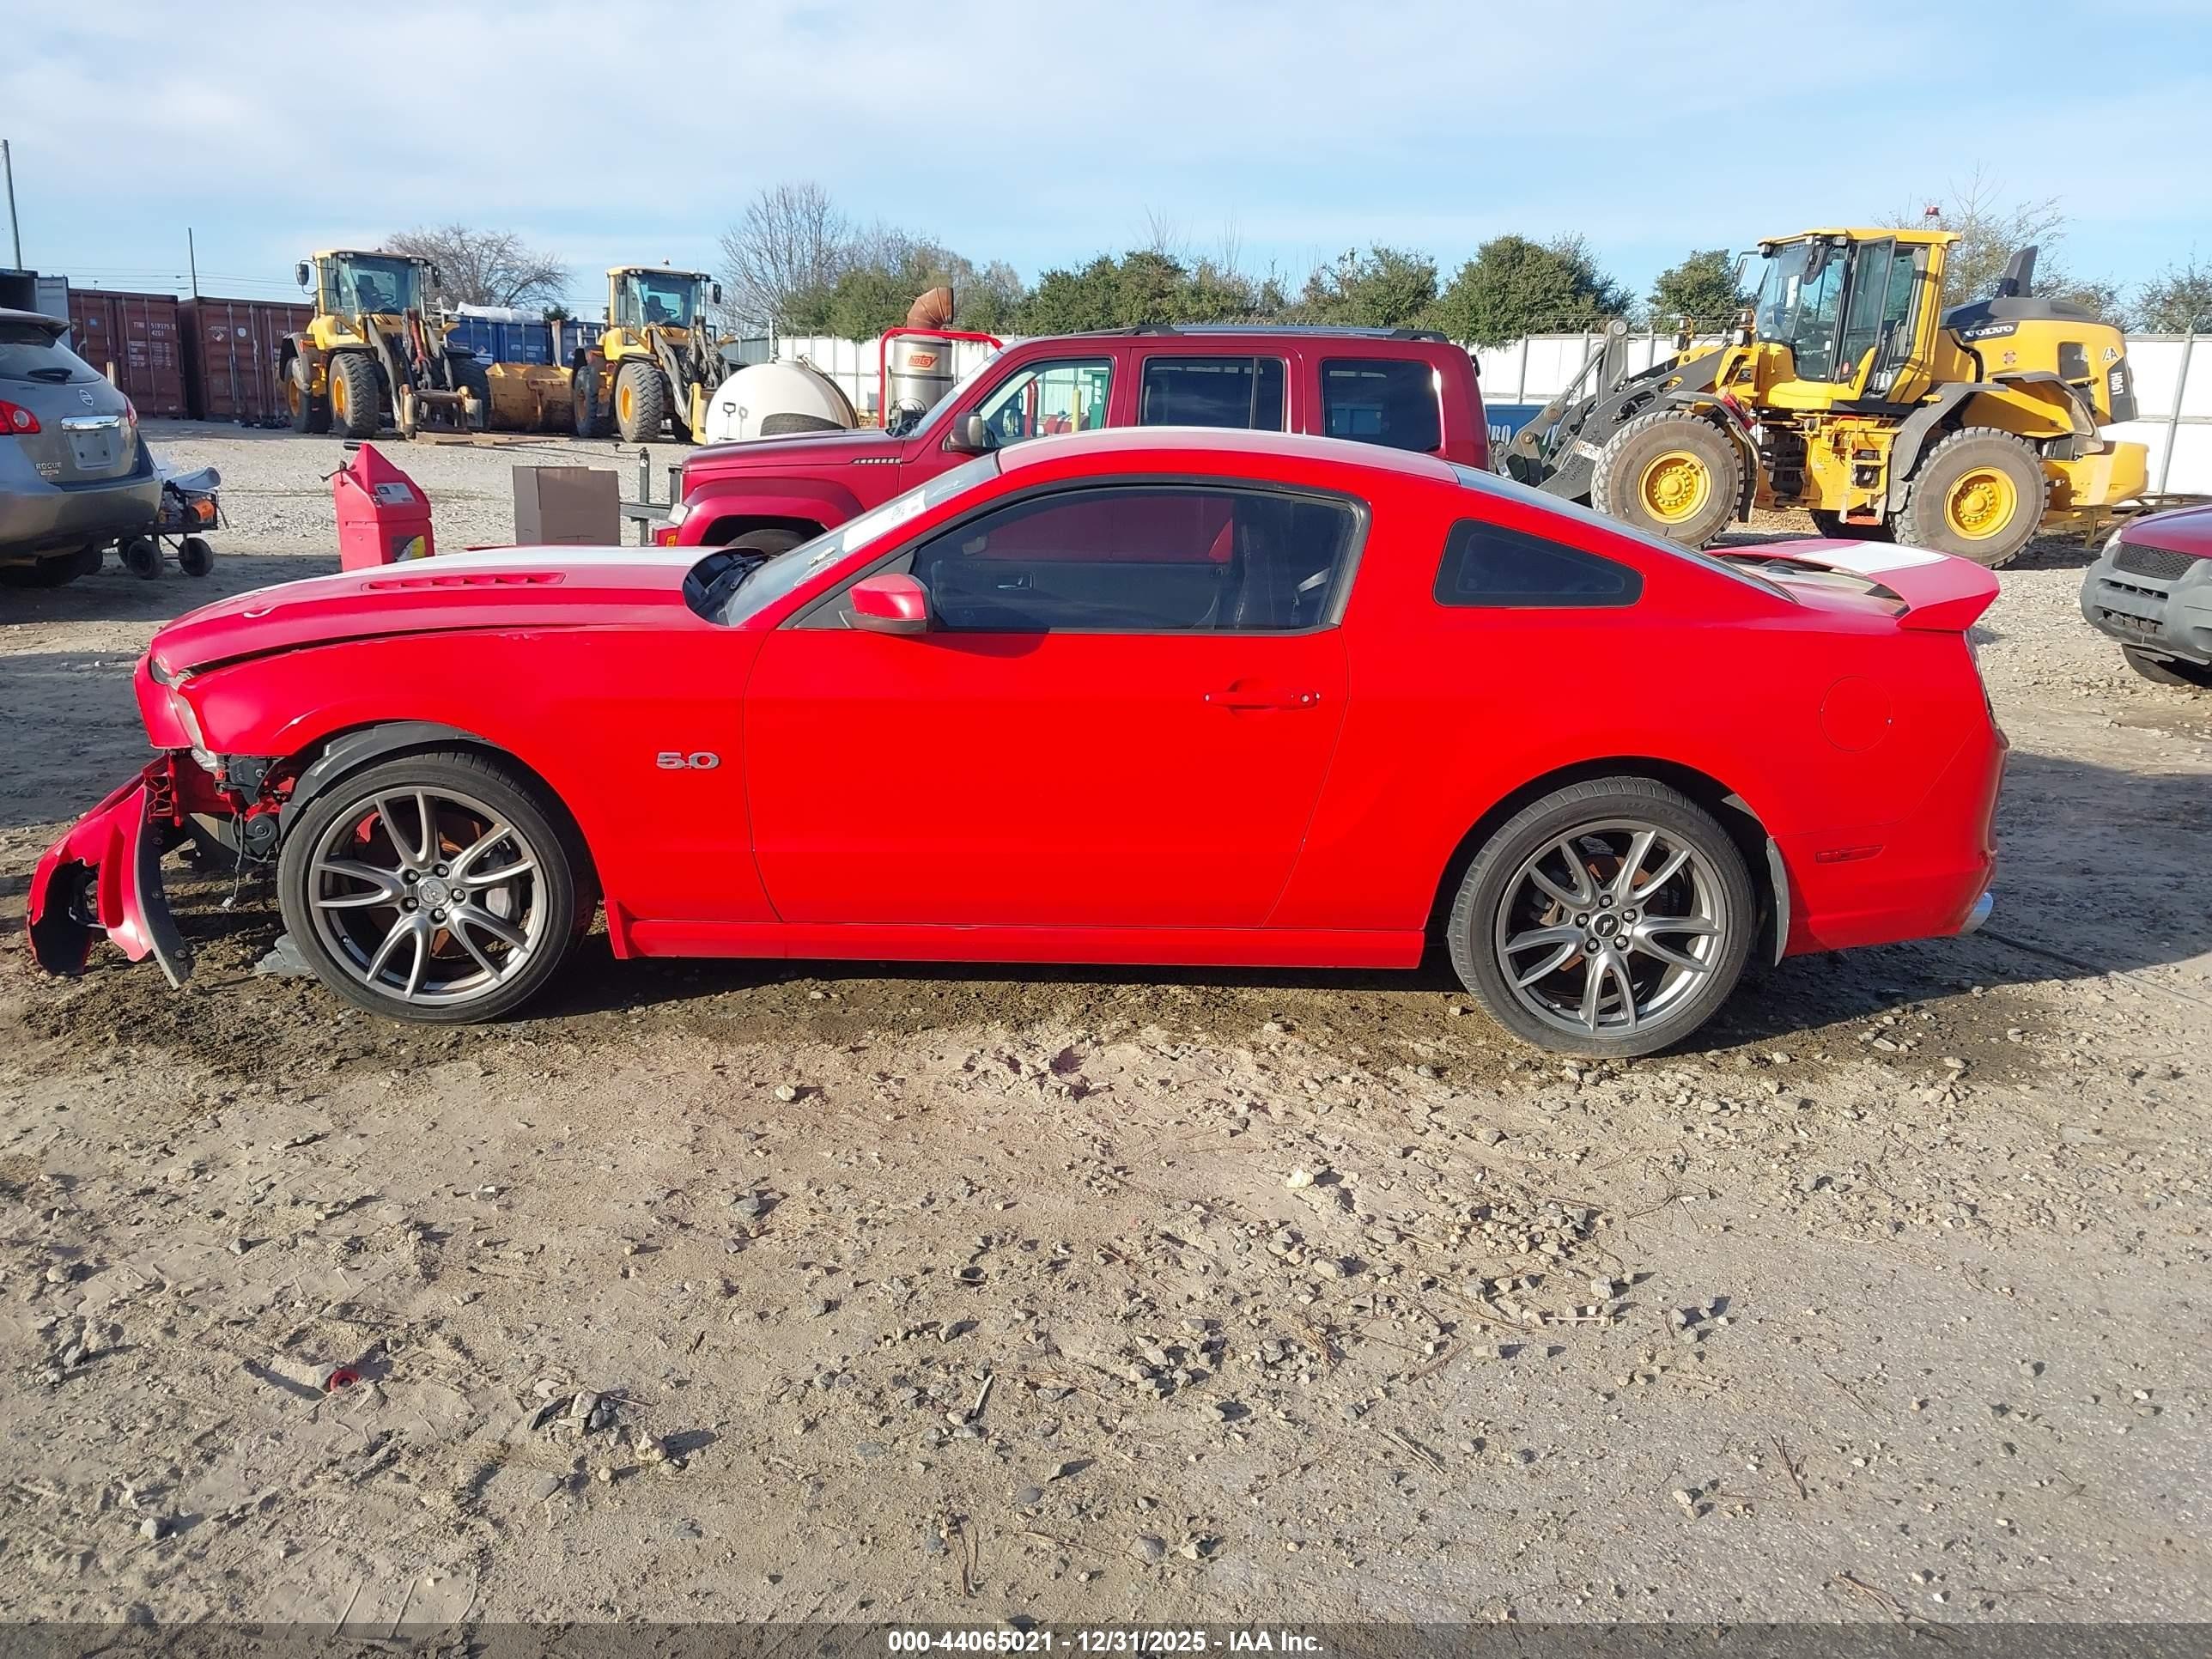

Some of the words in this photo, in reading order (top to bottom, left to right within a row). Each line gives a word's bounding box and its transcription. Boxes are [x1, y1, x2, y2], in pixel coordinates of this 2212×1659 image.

[1964, 325, 2014, 337] VOLVO
[2110, 371, 2124, 396] L90H
[35, 461, 63, 470] ROGUE
[656, 751, 720, 769] 5.0
